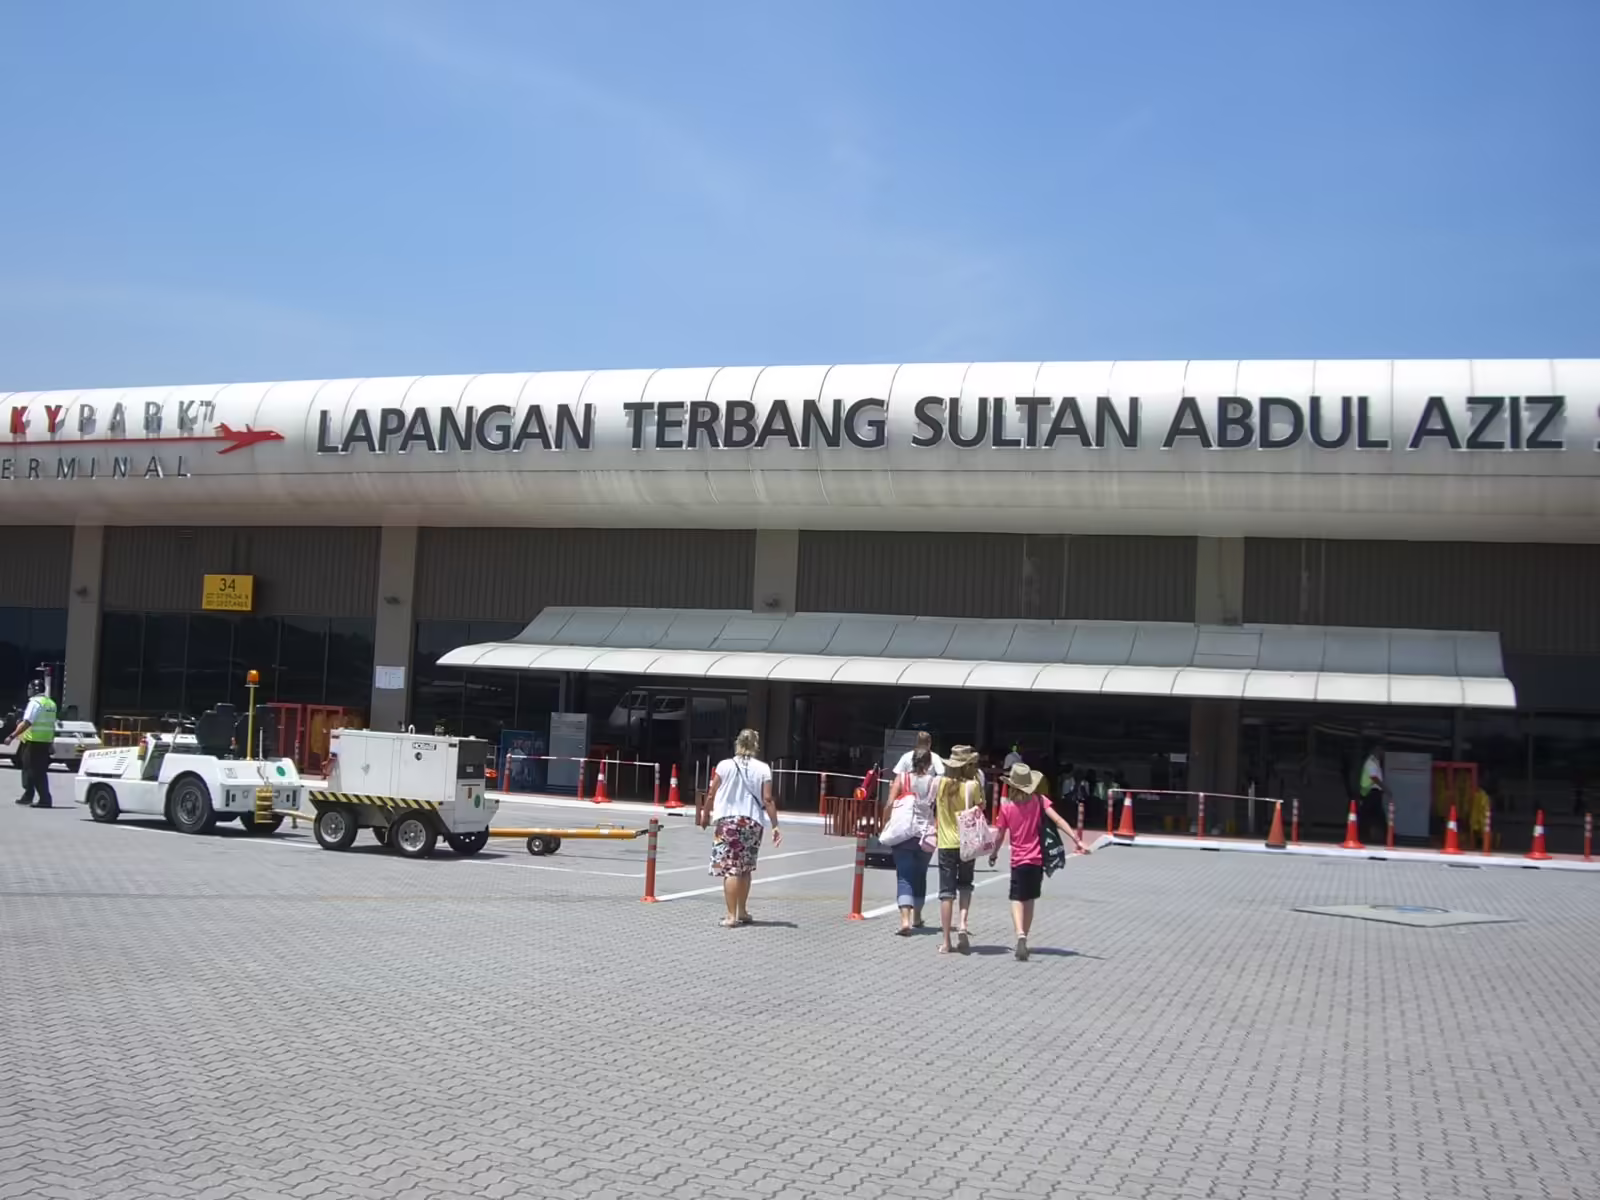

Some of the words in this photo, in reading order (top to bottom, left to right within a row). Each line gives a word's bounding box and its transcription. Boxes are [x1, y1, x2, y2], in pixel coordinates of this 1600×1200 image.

[317, 403, 594, 453] LAPANGAN
[623, 398, 888, 449] TERBANG
[911, 396, 1139, 449] SULTAN
[1161, 396, 1390, 450] ABDUL
[1408, 396, 1566, 450] AZIZ
[219, 577, 236, 592] 34
